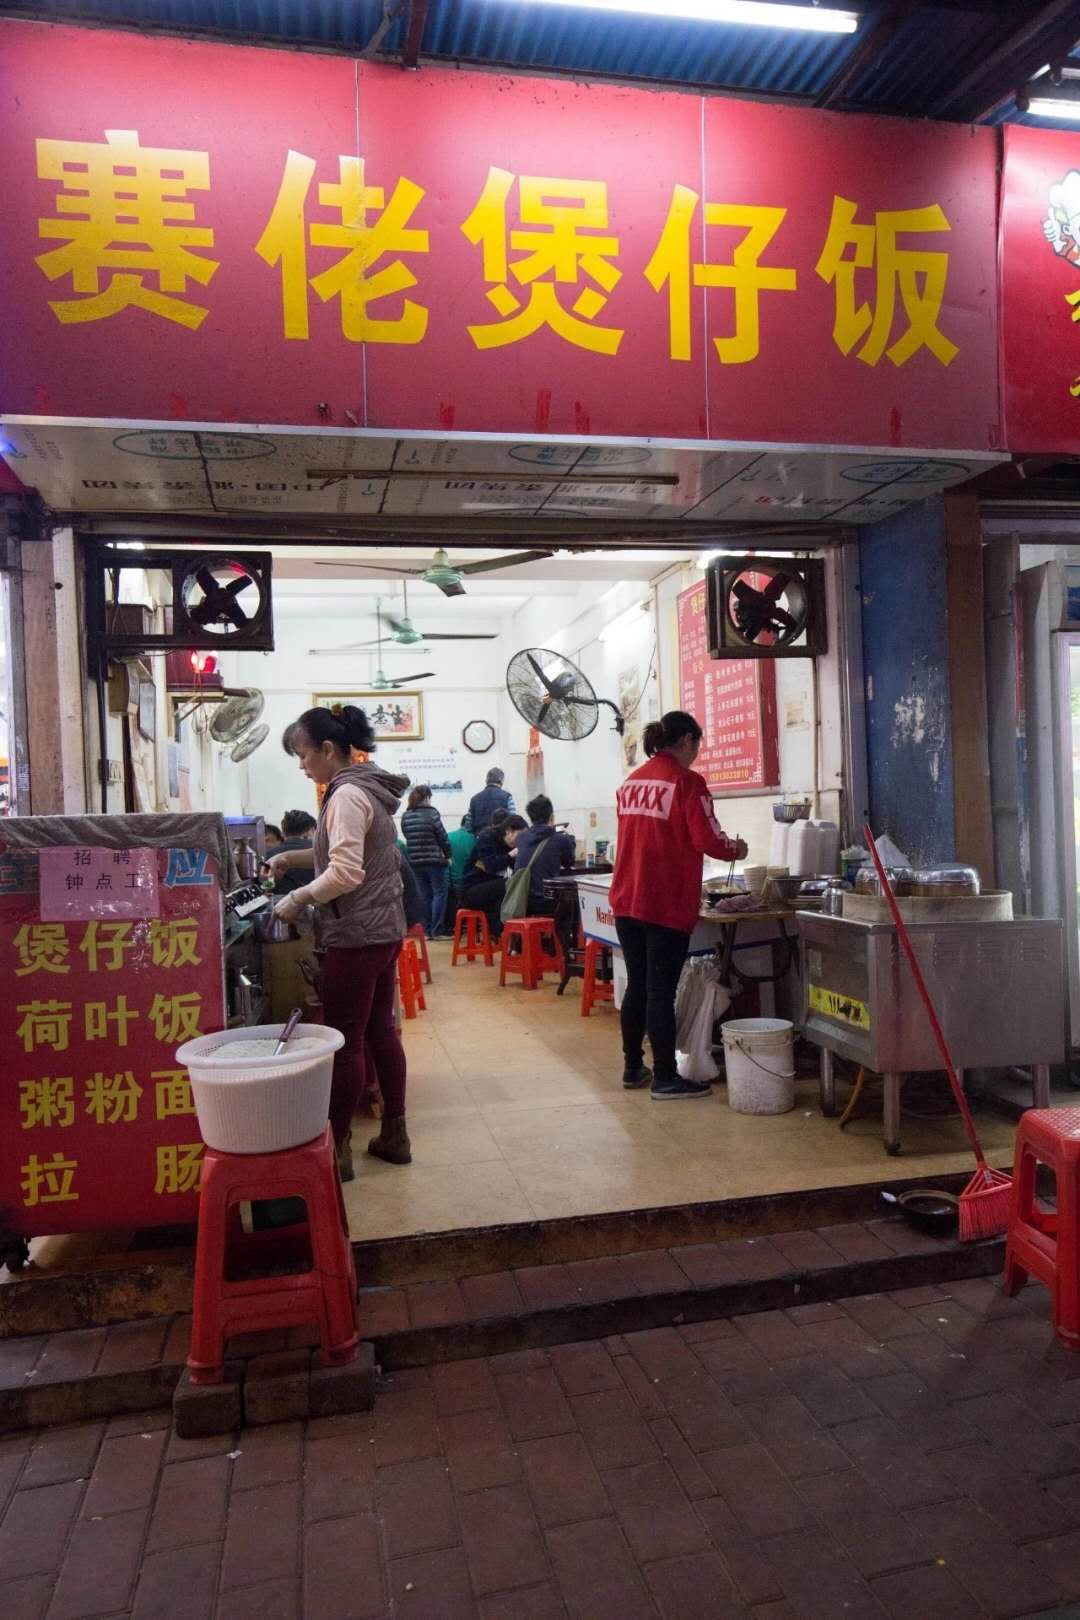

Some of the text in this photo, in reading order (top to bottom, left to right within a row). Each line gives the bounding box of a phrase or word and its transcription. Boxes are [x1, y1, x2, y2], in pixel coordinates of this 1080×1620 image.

[34, 129, 960, 367] 赛佬煲仔饭
[65, 873, 146, 891] 钟点工
[74, 849, 130, 866] 招聘
[13, 916, 202, 976] 煲仔饭
[16, 992, 203, 1053] 荷叶饭
[18, 1070, 198, 1130] 粥粉面
